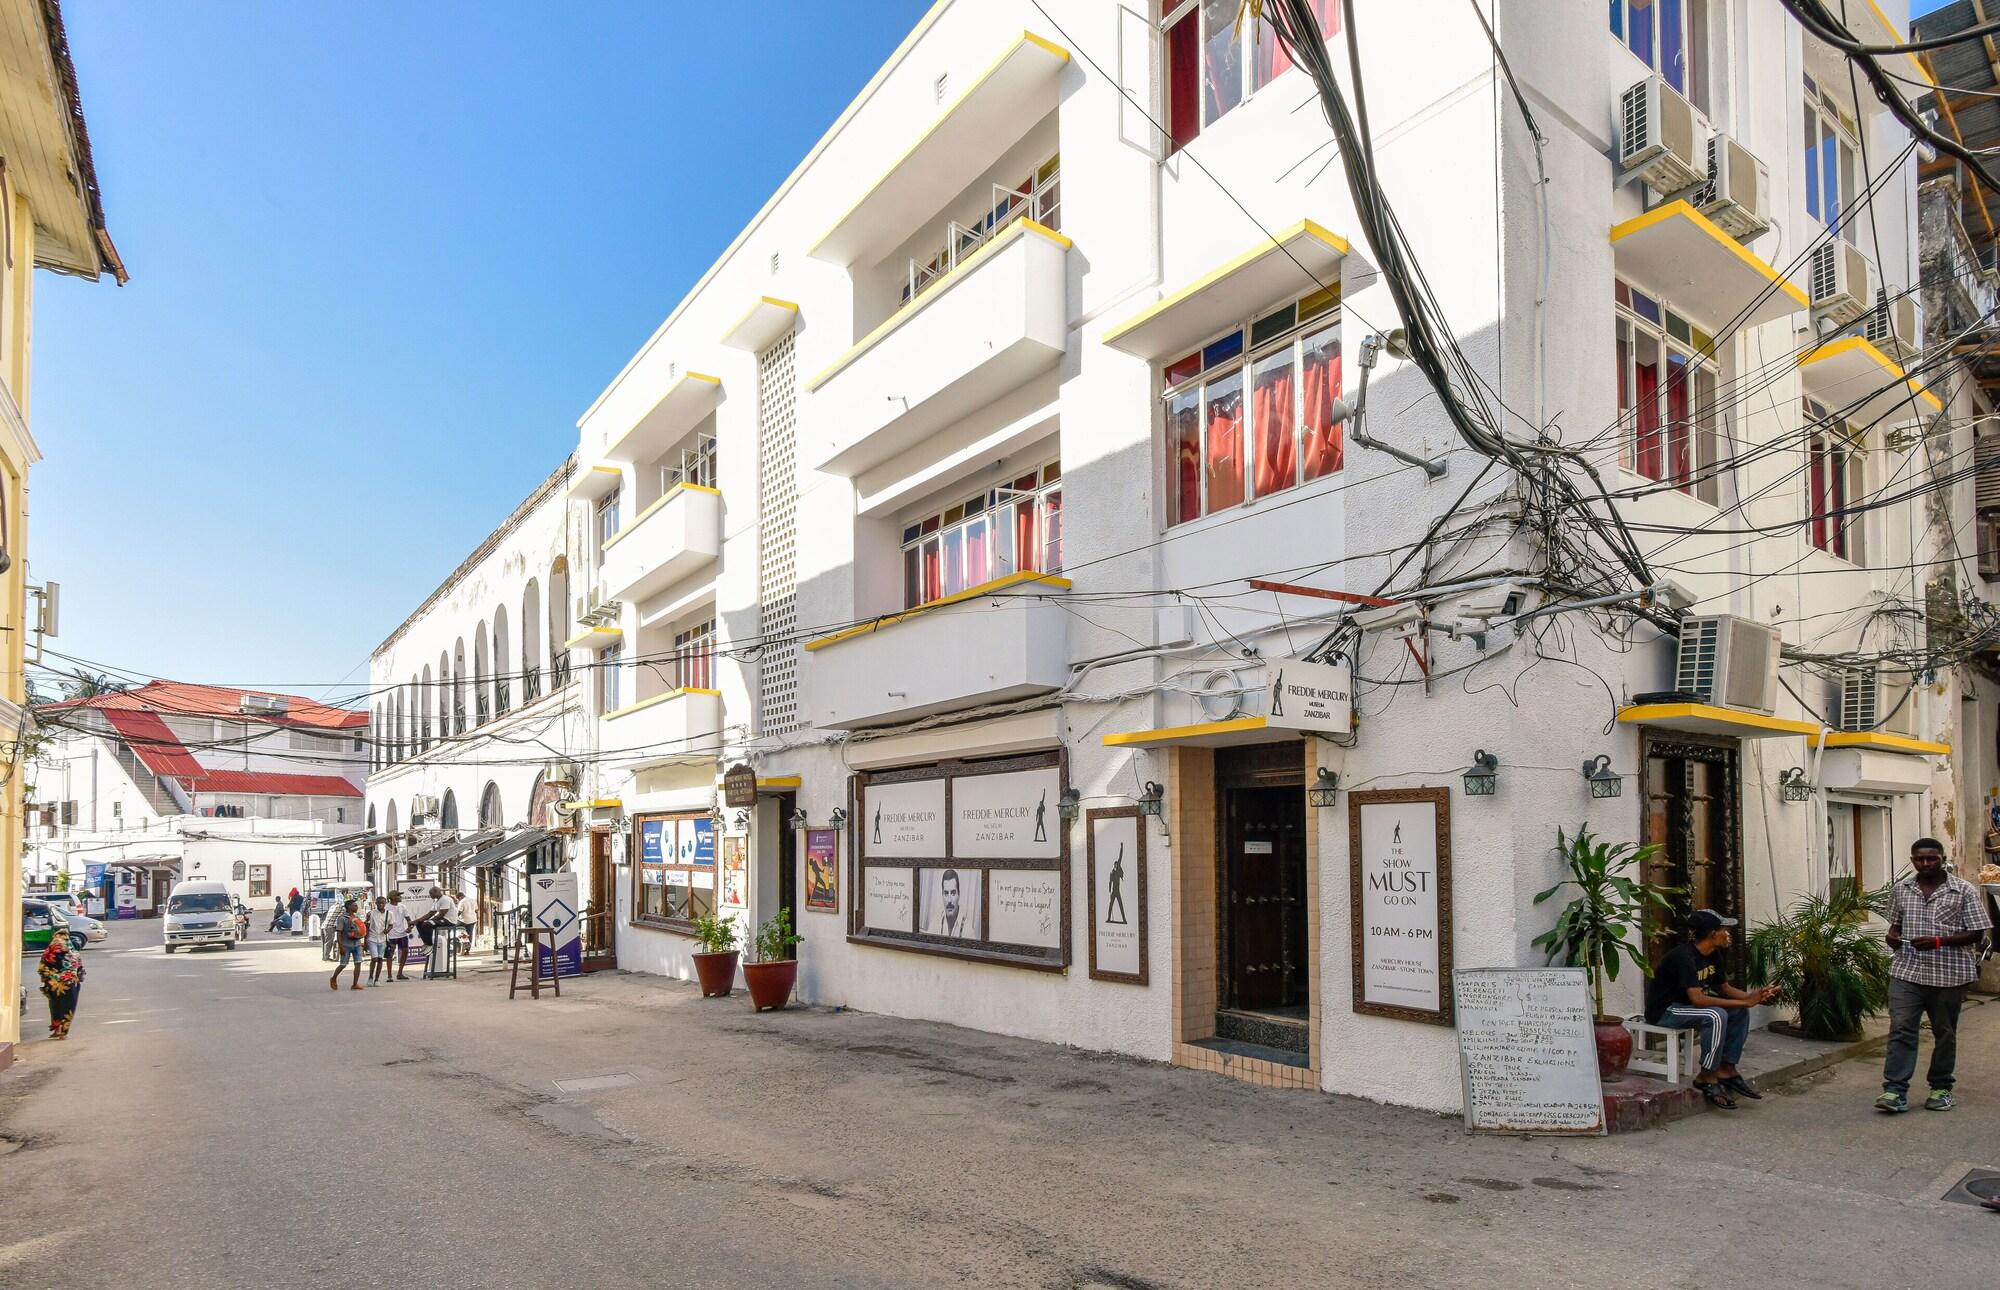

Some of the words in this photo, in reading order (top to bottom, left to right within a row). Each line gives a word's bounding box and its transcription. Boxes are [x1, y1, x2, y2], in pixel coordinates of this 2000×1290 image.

[1287, 684, 1317, 698] FREDDIE
[1318, 688, 1349, 702] MERCURY
[1303, 709, 1331, 720] ZANZIBAR
[883, 812, 907, 824] FREDDIE
[908, 810, 937, 822] MERCURY
[962, 808, 993, 820] FREDDIE
[994, 806, 1031, 819] MERCURY
[893, 833, 925, 842] ZANZIBAR
[975, 832, 1015, 841] ZANZIBAR
[1391, 847, 1404, 855] THE
[1382, 858, 1412, 869] SHOW
[1369, 871, 1432, 893] MUST
[1383, 895, 1399, 906] GO
[1401, 895, 1417, 906] ON
[1370, 926, 1382, 936] 10
[1383, 927, 1400, 937] AM
[1407, 928, 1414, 938] 6
[1416, 928, 1433, 940] PM
[1380, 958, 1404, 966] MERCURY
[1400, 966, 1416, 974] STONE
[1472, 1053, 1523, 1063] ZANZIBAR
